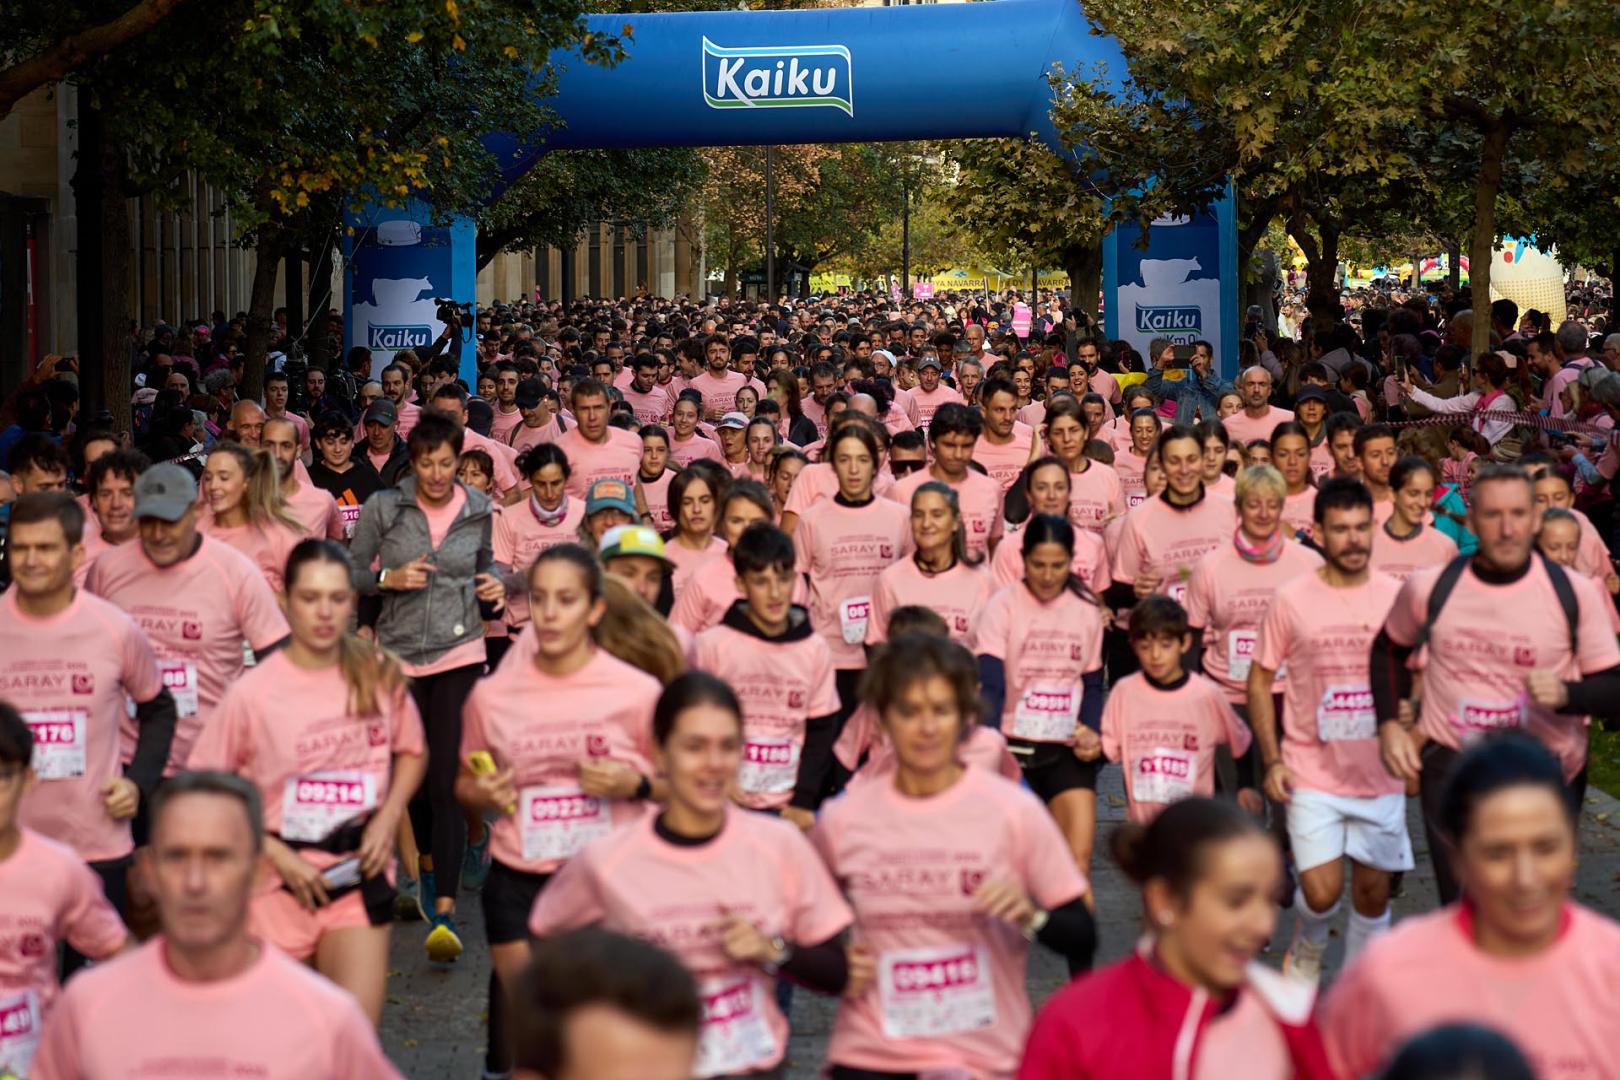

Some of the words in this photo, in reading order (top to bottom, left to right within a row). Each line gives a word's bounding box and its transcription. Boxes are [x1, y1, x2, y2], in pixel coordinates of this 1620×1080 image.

[717, 57, 836, 106] Kaiku
[1140, 310, 1196, 333] Kaiku
[372, 328, 426, 351] Kaiku
[990, 471, 1015, 479] ARAY
[831, 544, 876, 555] SARAY
[1163, 547, 1209, 562] SARAY
[1228, 600, 1269, 609] SARA
[141, 618, 177, 631] RAY
[297, 780, 363, 804] 09214
